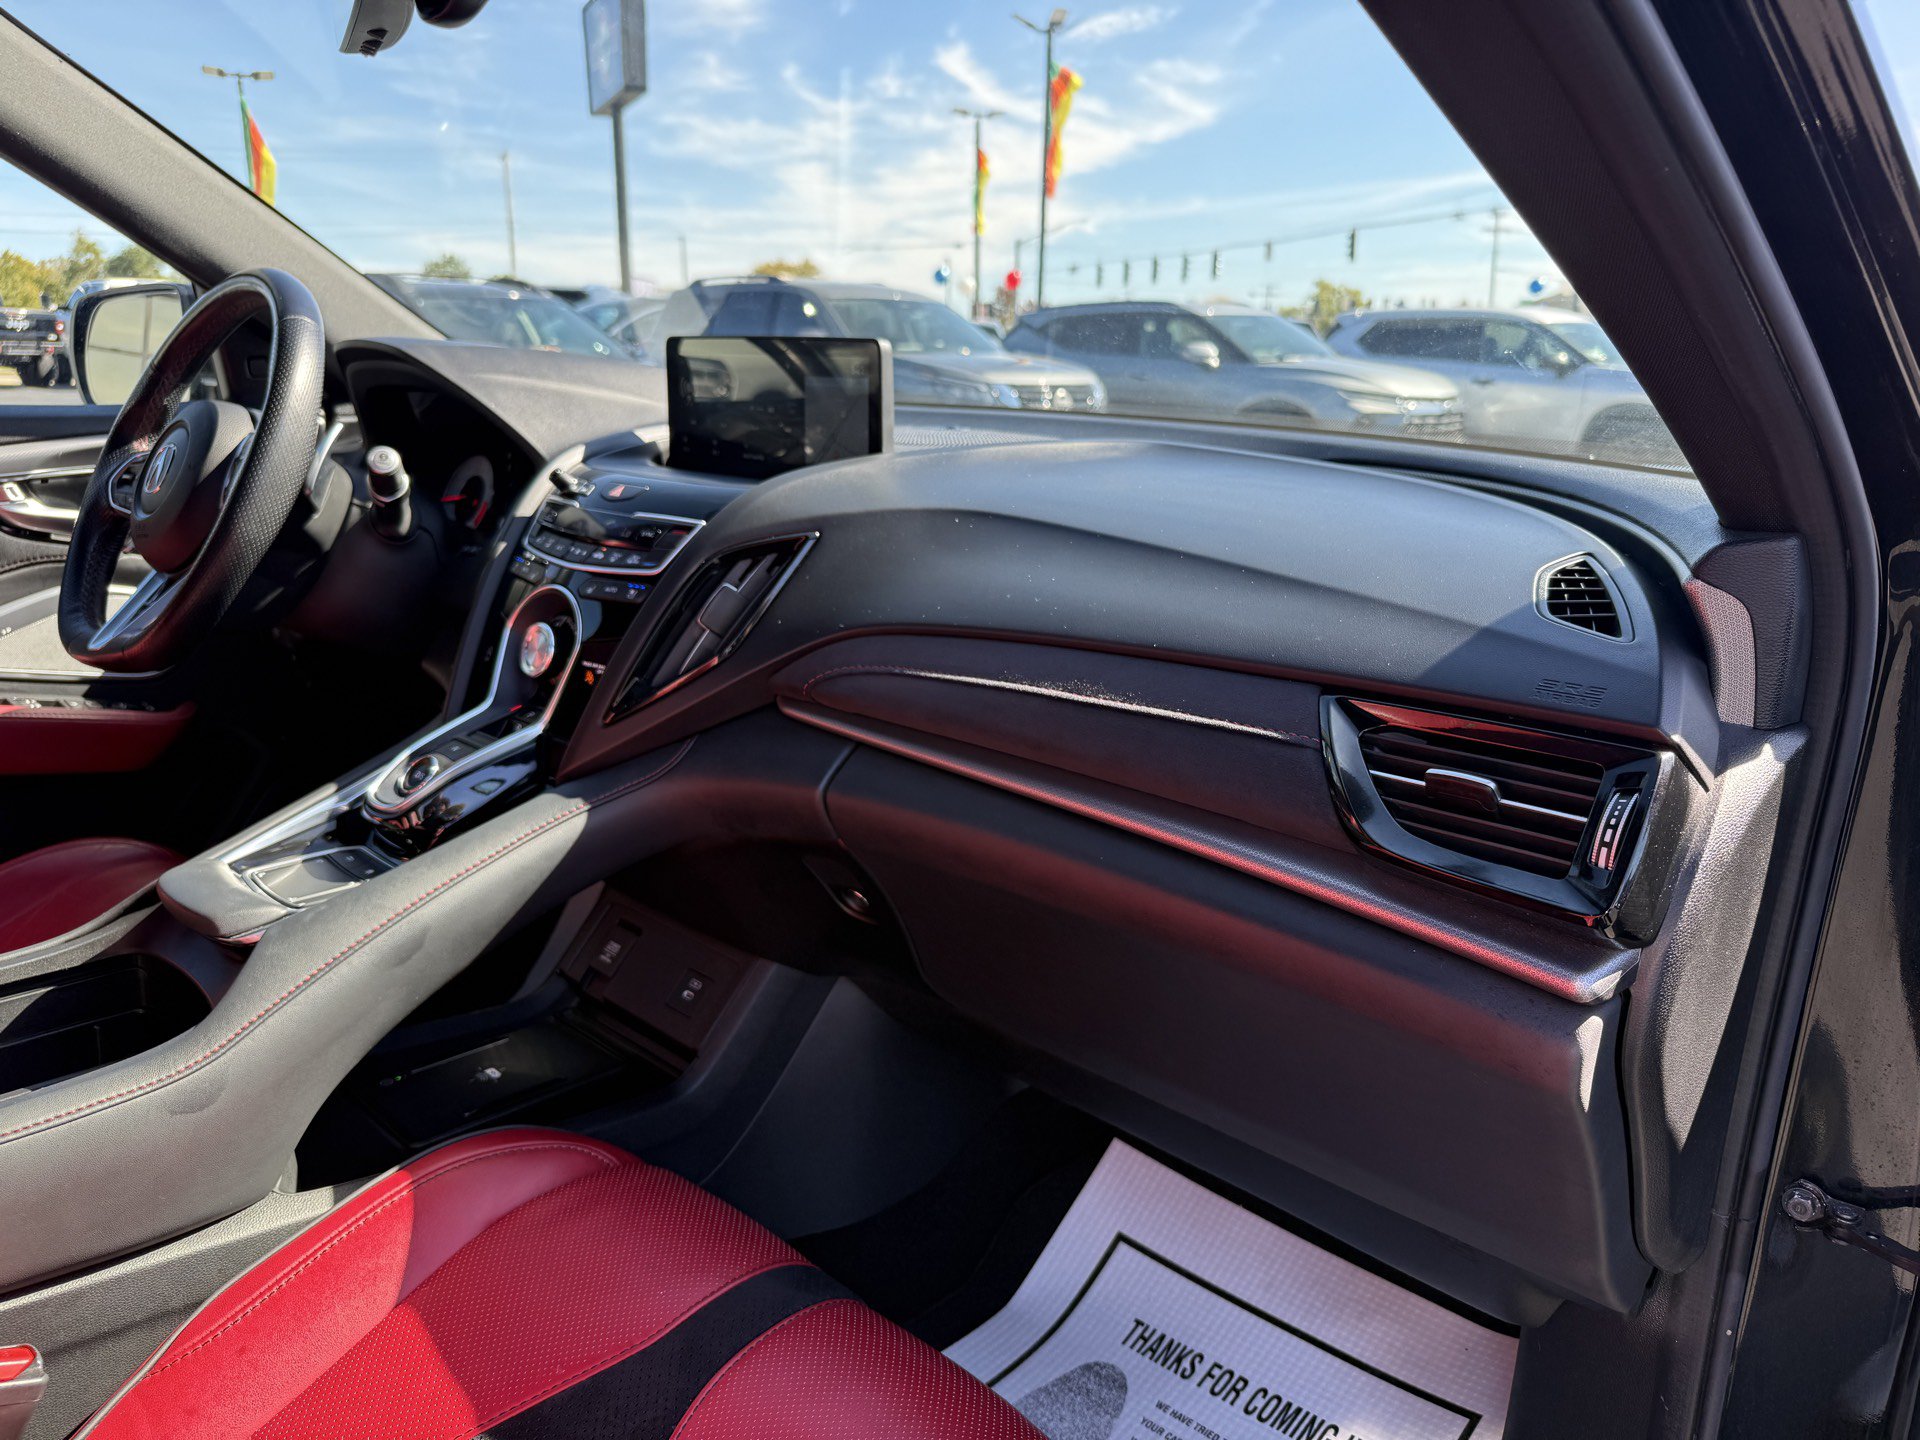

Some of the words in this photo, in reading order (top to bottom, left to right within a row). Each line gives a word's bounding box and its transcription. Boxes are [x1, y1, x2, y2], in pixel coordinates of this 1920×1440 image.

[1121, 1317, 1205, 1379] THANKS
[1196, 1361, 1249, 1406] FOR
[1140, 1416, 1165, 1436] YOUR
[1155, 1400, 1171, 1413] WE
[1169, 1409, 1194, 1427] HAVE
[1193, 1422, 1220, 1440] TRIED
